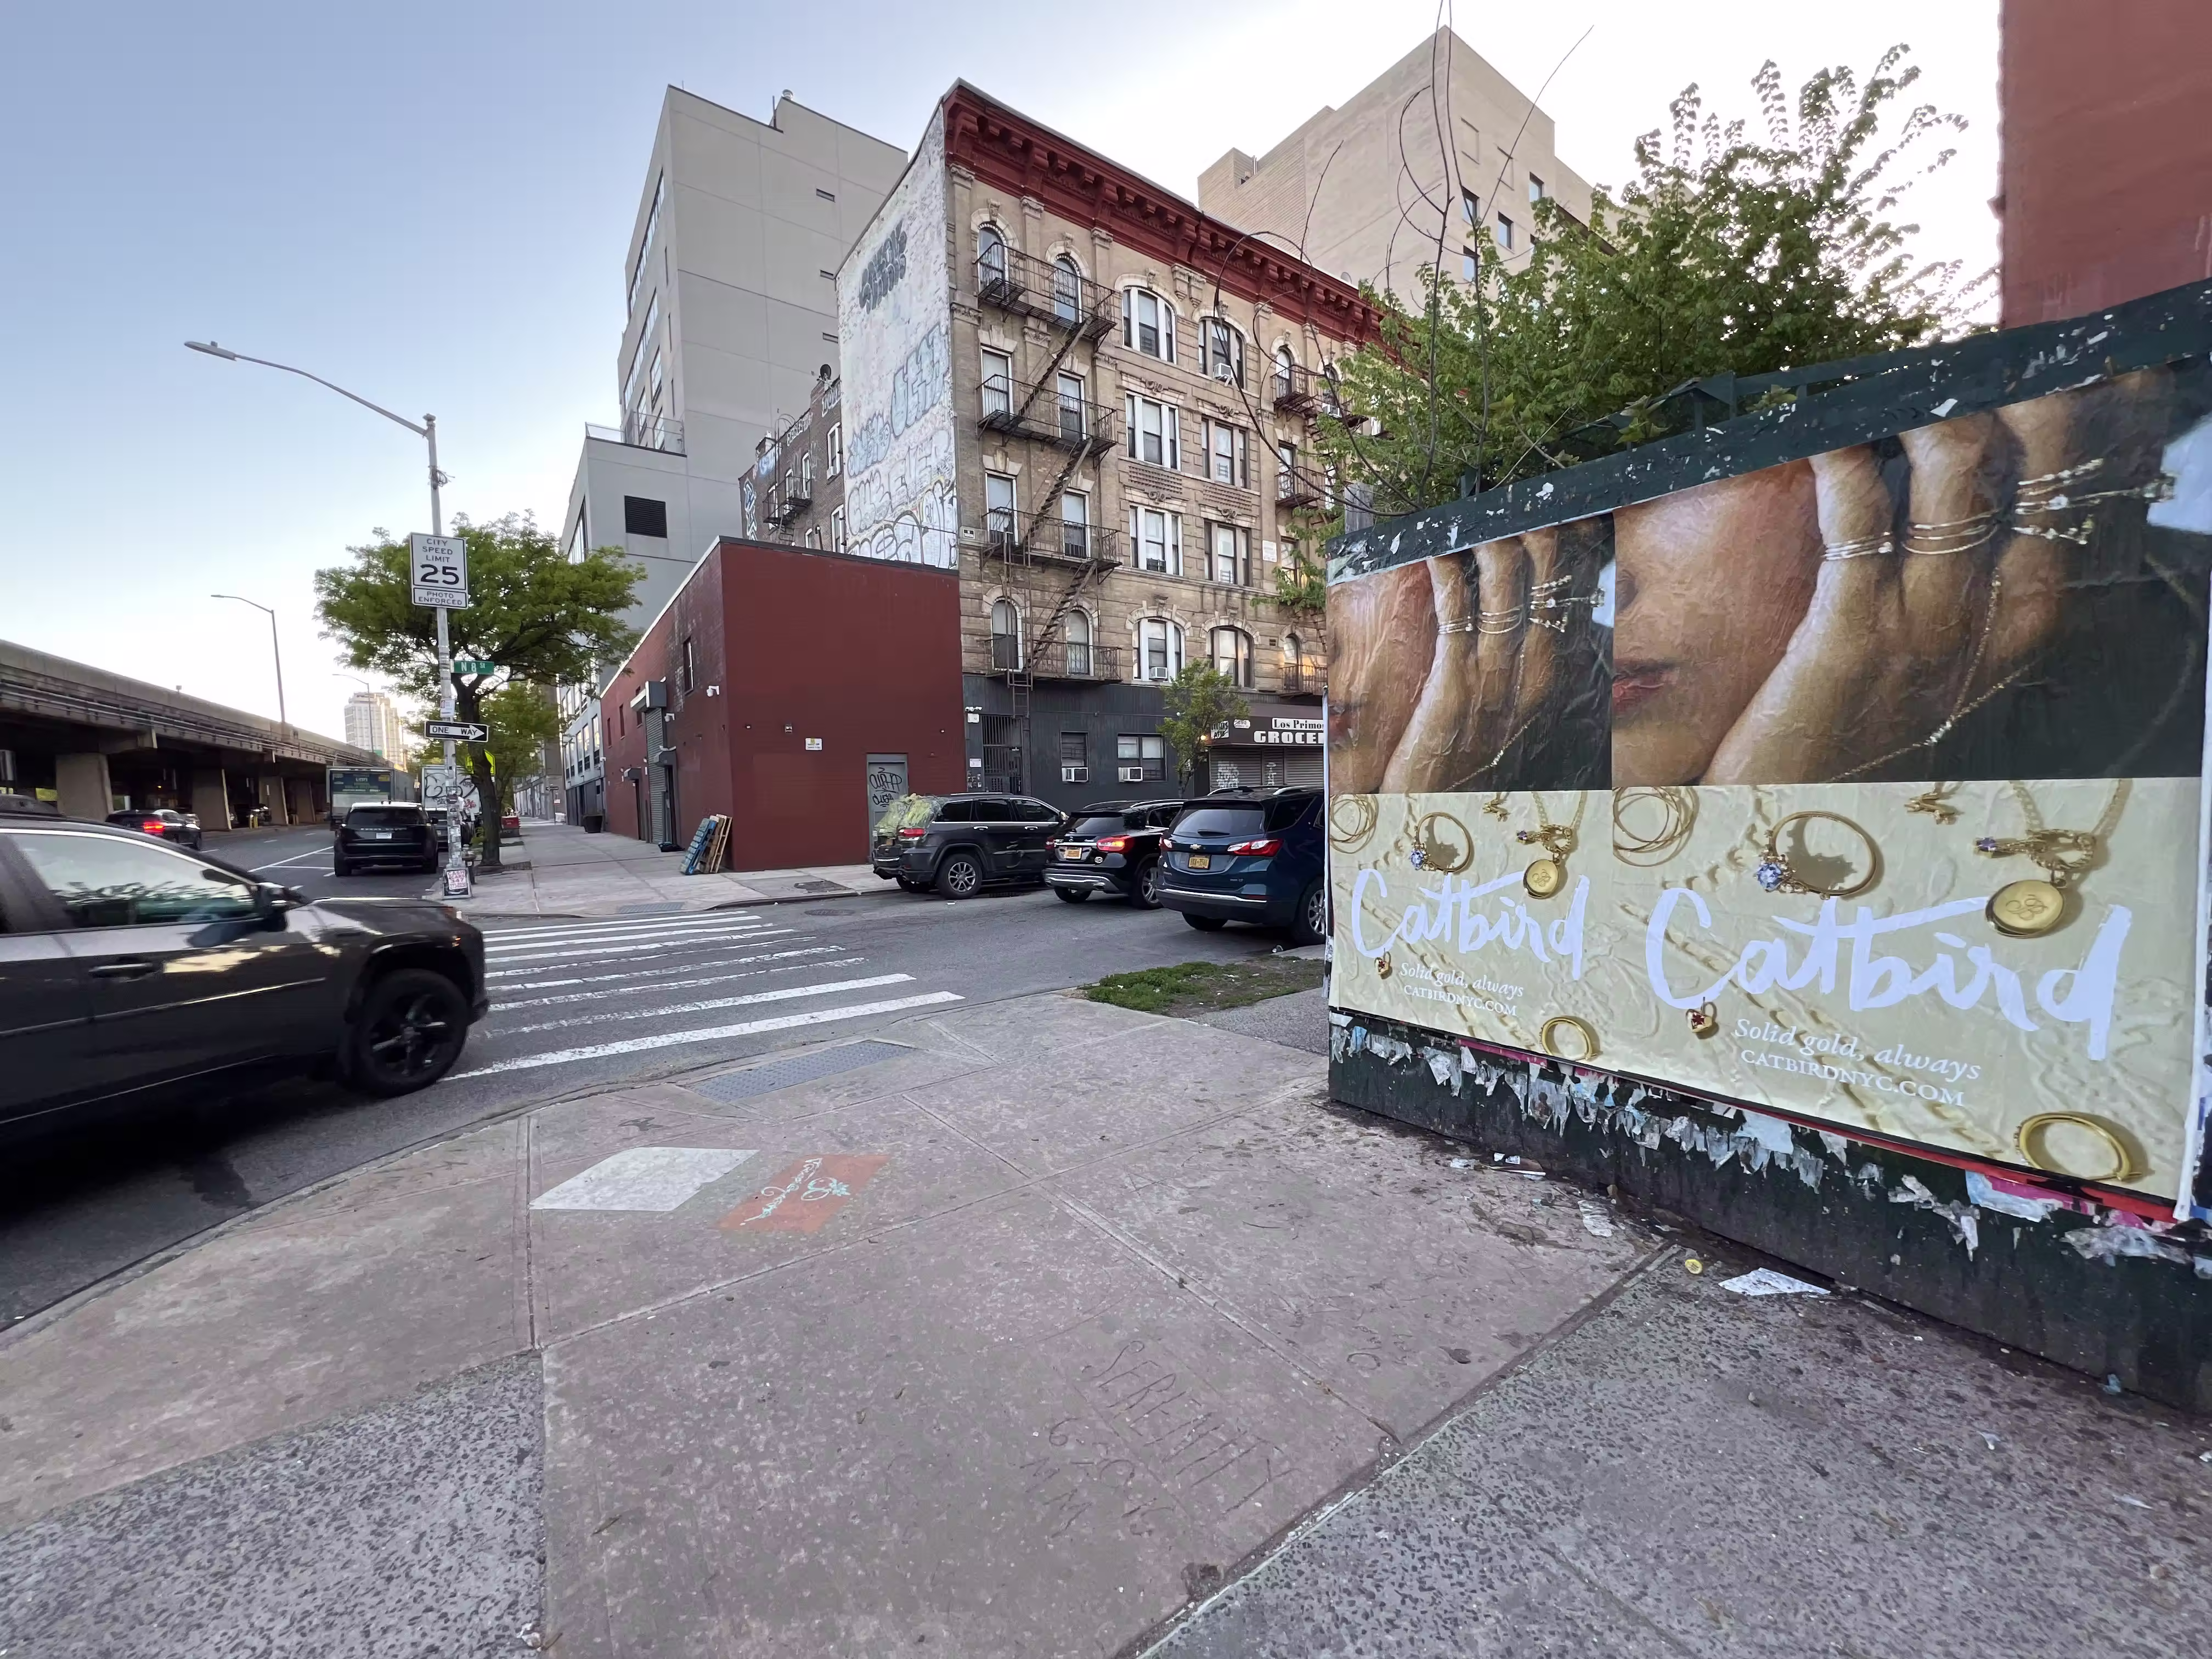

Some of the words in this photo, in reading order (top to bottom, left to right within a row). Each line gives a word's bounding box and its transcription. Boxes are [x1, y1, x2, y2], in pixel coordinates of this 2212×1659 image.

[422, 546, 453, 555] SPEED
[420, 564, 459, 585] 25
[419, 596, 462, 605] ENFORCED
[461, 662, 466, 672] N
[471, 663, 476, 672] 8
[1274, 719, 1290, 729] Los
[1351, 868, 1590, 980] Catbird
[1400, 962, 1433, 980] Solid
[1434, 970, 1468, 989] gold,
[1472, 974, 1523, 1000] always
[1645, 887, 2131, 1061] Catbird
[1404, 984, 1517, 1016] CATBIRDNYC.COM
[1734, 1018, 1796, 1047] Solid
[1801, 1033, 1865, 1062] gold,
[1873, 1043, 1982, 1080] always
[1740, 1048, 1965, 1106] CATBIRDNYC.COM
